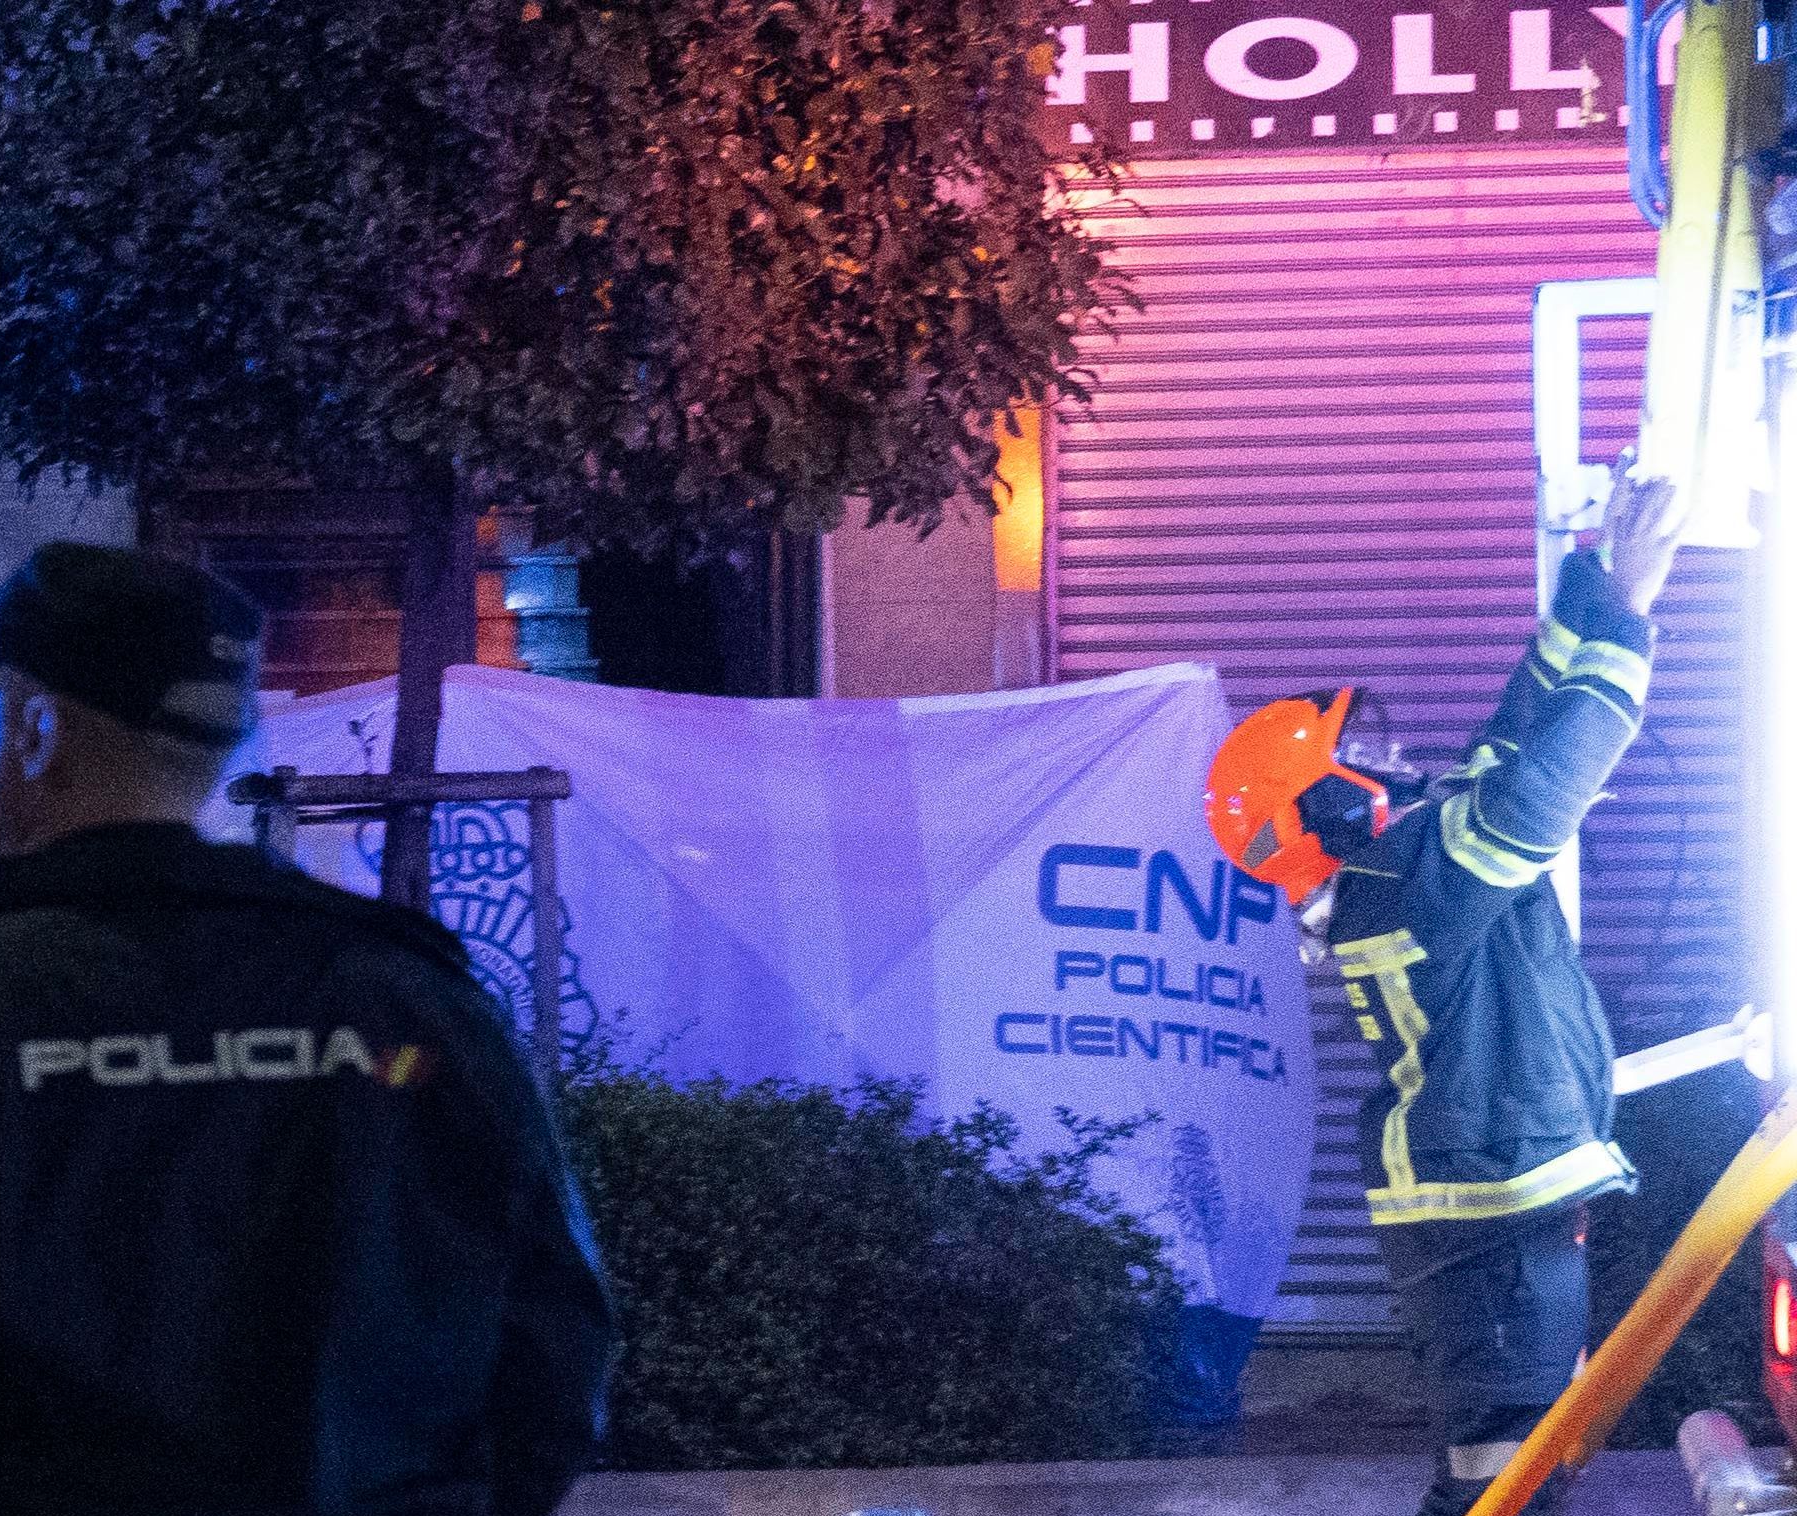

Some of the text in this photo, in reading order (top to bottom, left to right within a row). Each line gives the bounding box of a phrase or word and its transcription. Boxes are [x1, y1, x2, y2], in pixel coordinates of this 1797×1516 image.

[1038, 843, 1277, 945] CNP
[1055, 950, 1268, 1016] POLICIA
[17, 1026, 377, 1092] POLICIA
